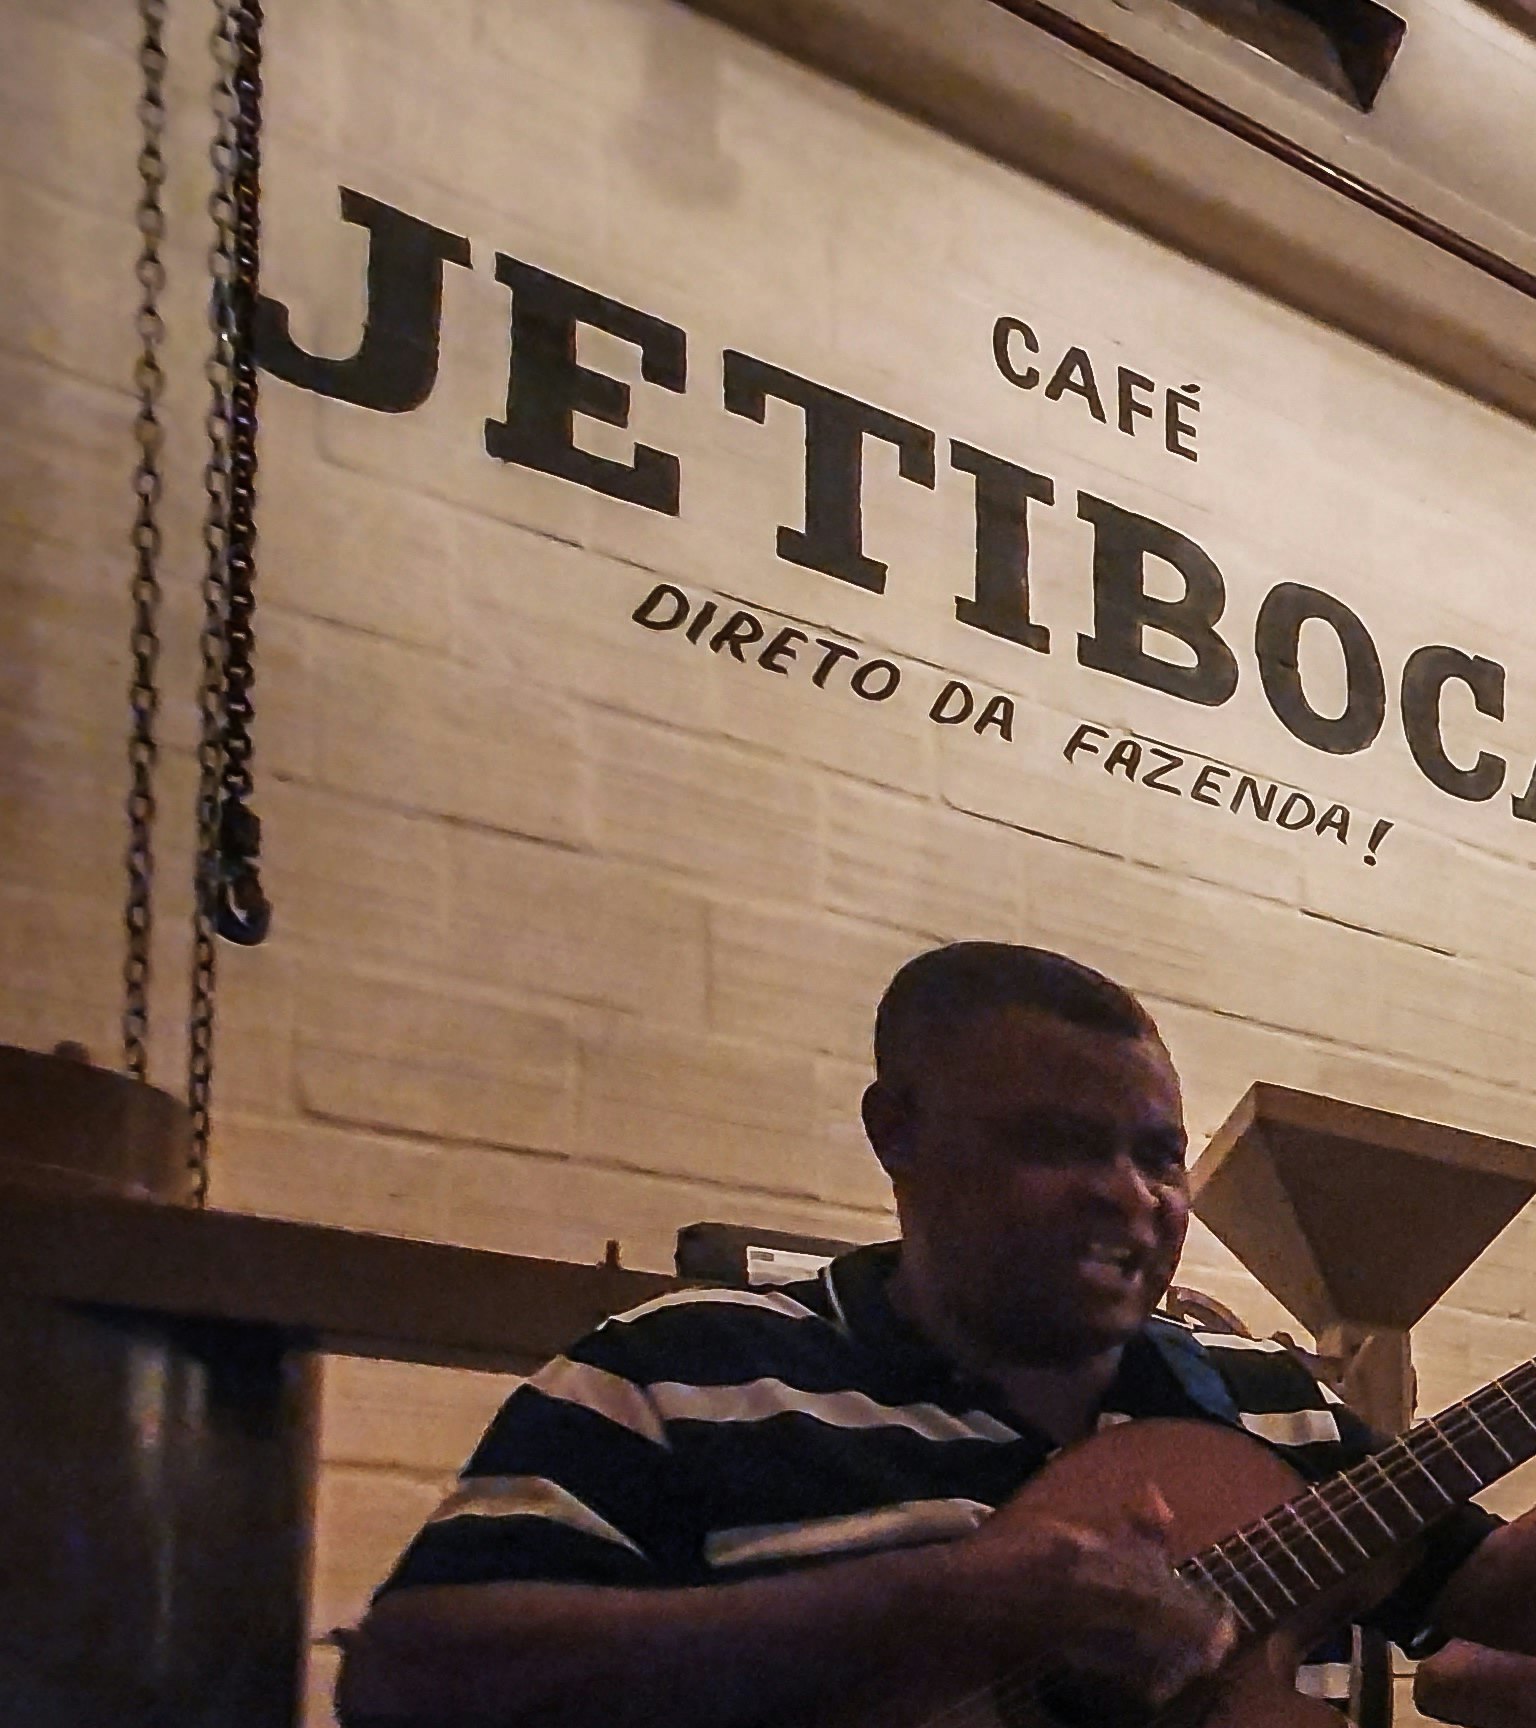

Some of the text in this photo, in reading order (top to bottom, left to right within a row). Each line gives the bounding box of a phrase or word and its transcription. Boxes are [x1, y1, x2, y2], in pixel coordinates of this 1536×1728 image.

[992, 317, 1201, 463] CAFÉ
[631, 583, 1395, 868] DIRETO DA FAZENDA!
